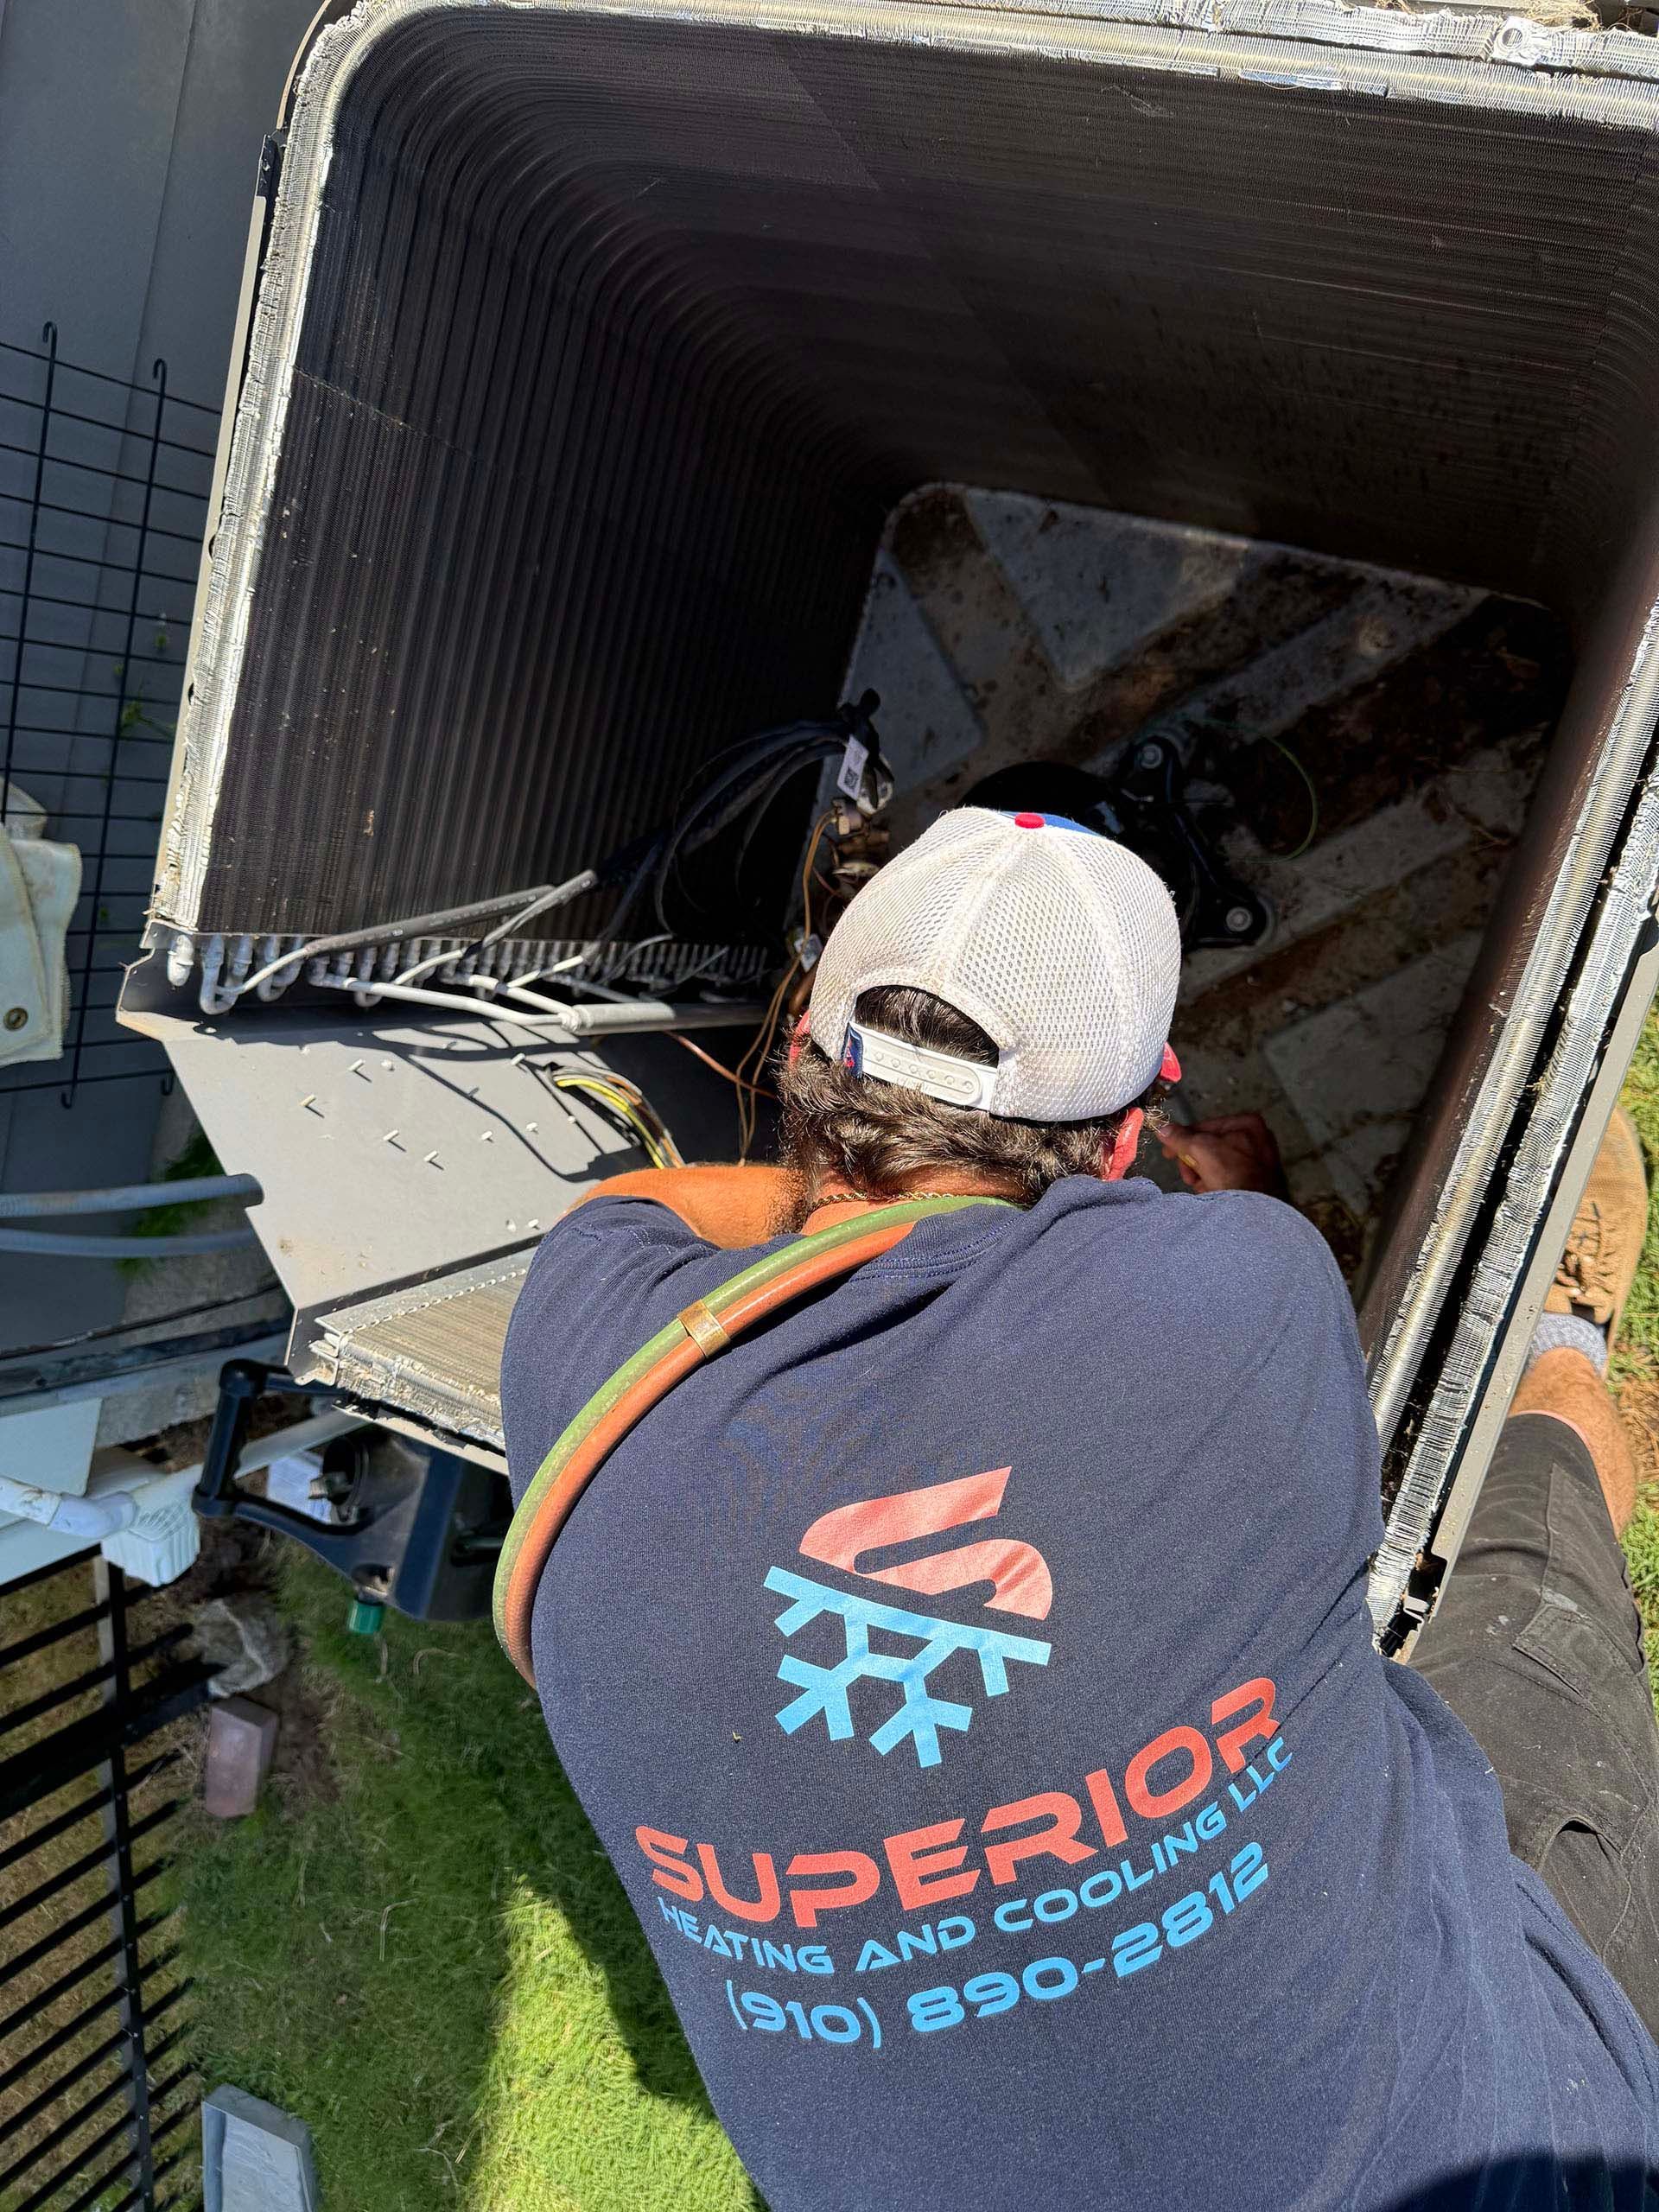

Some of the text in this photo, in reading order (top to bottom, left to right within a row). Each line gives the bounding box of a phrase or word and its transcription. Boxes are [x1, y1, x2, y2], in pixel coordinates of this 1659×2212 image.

[635, 1677, 1281, 1928] SUPERIOR
[658, 1737, 1293, 1975] HEATING AND COOLING LLC
[725, 1841, 1269, 2050] (910) 890-2812
